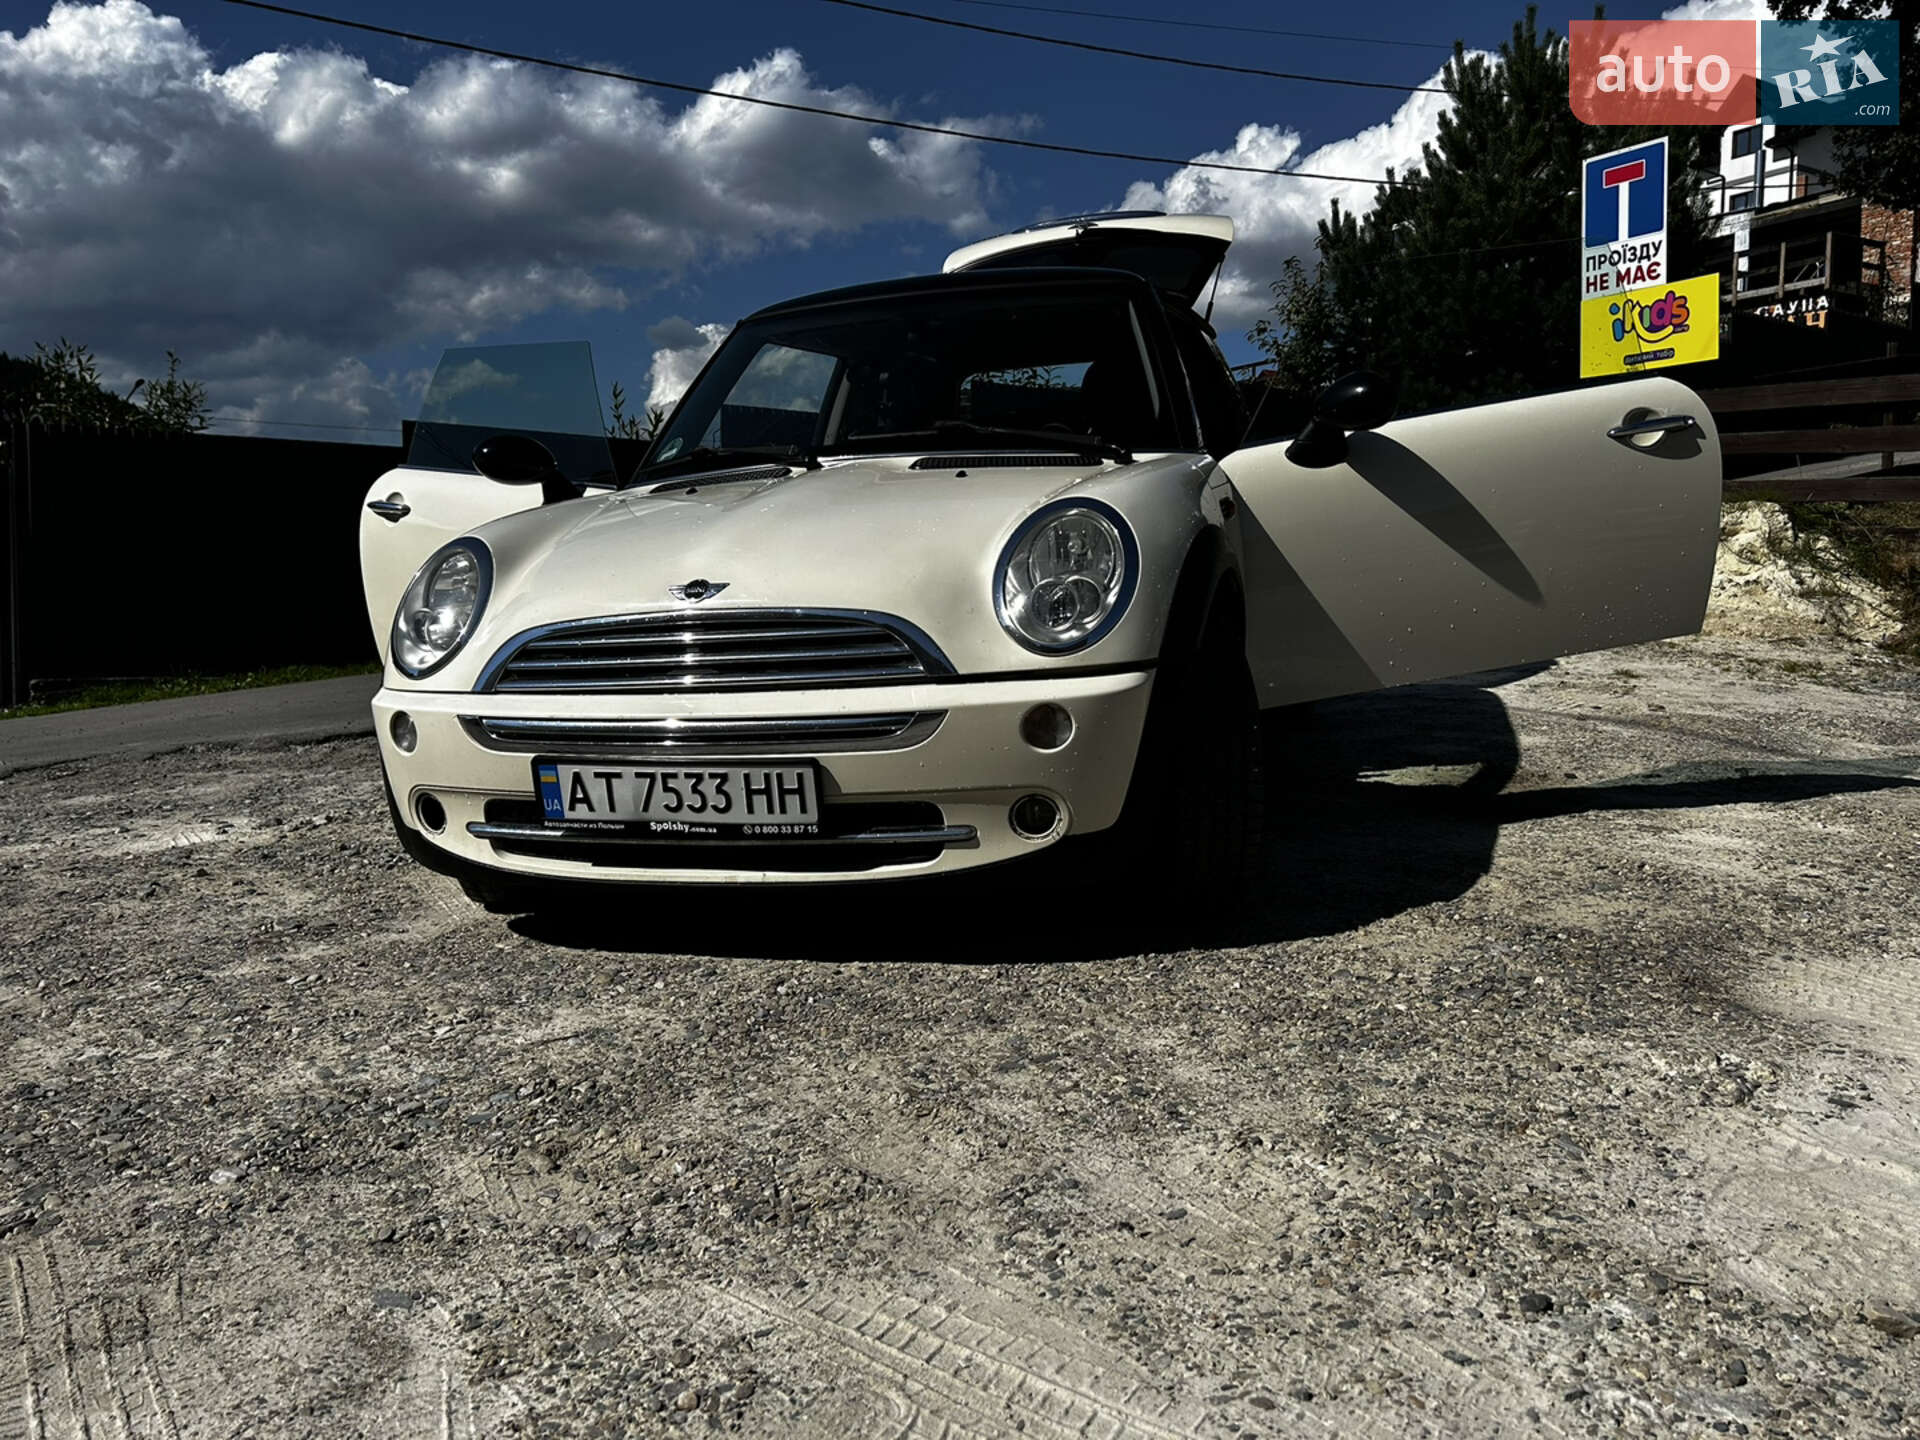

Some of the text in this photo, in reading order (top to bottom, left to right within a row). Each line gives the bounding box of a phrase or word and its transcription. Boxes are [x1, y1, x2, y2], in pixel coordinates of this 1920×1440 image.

[1585, 239, 1663, 273] ПРОЇЗДУ
[1585, 261, 1662, 294] НЕ МАЄ
[544, 799, 561, 811] UA
[567, 769, 808, 815] AT 7533 HH
